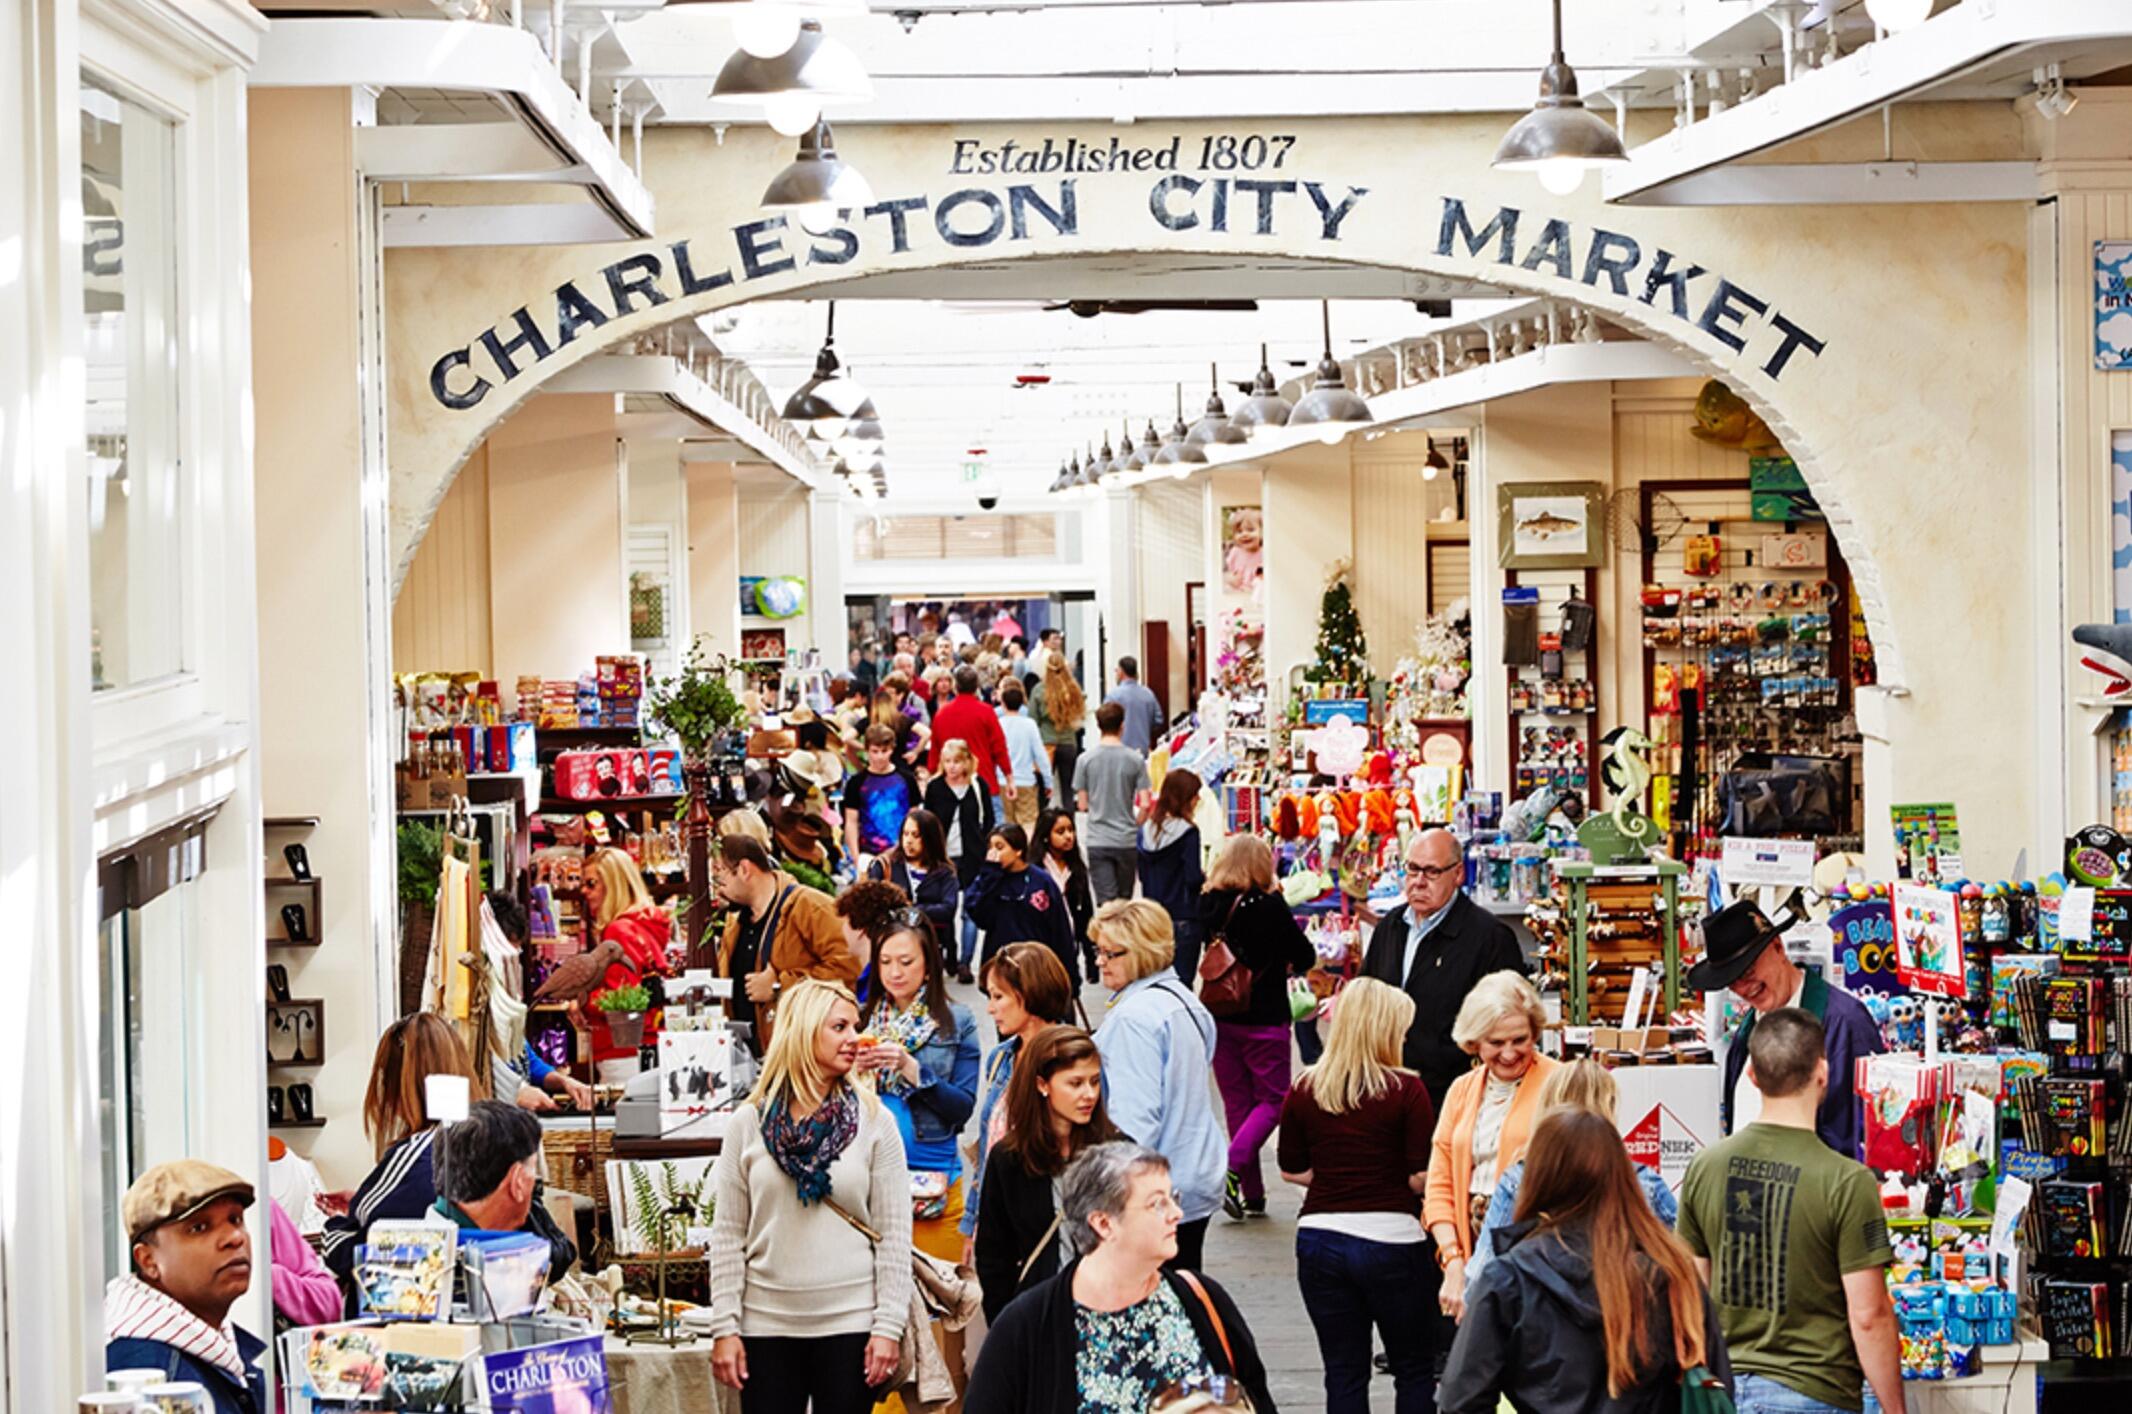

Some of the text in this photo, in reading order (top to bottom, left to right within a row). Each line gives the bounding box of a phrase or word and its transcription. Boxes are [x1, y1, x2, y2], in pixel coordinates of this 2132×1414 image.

[948, 135, 1297, 175] Established 1807
[429, 175, 1829, 410] CHARLESTON CITY MARKET
[1727, 1155, 1802, 1185] FREEDOM
